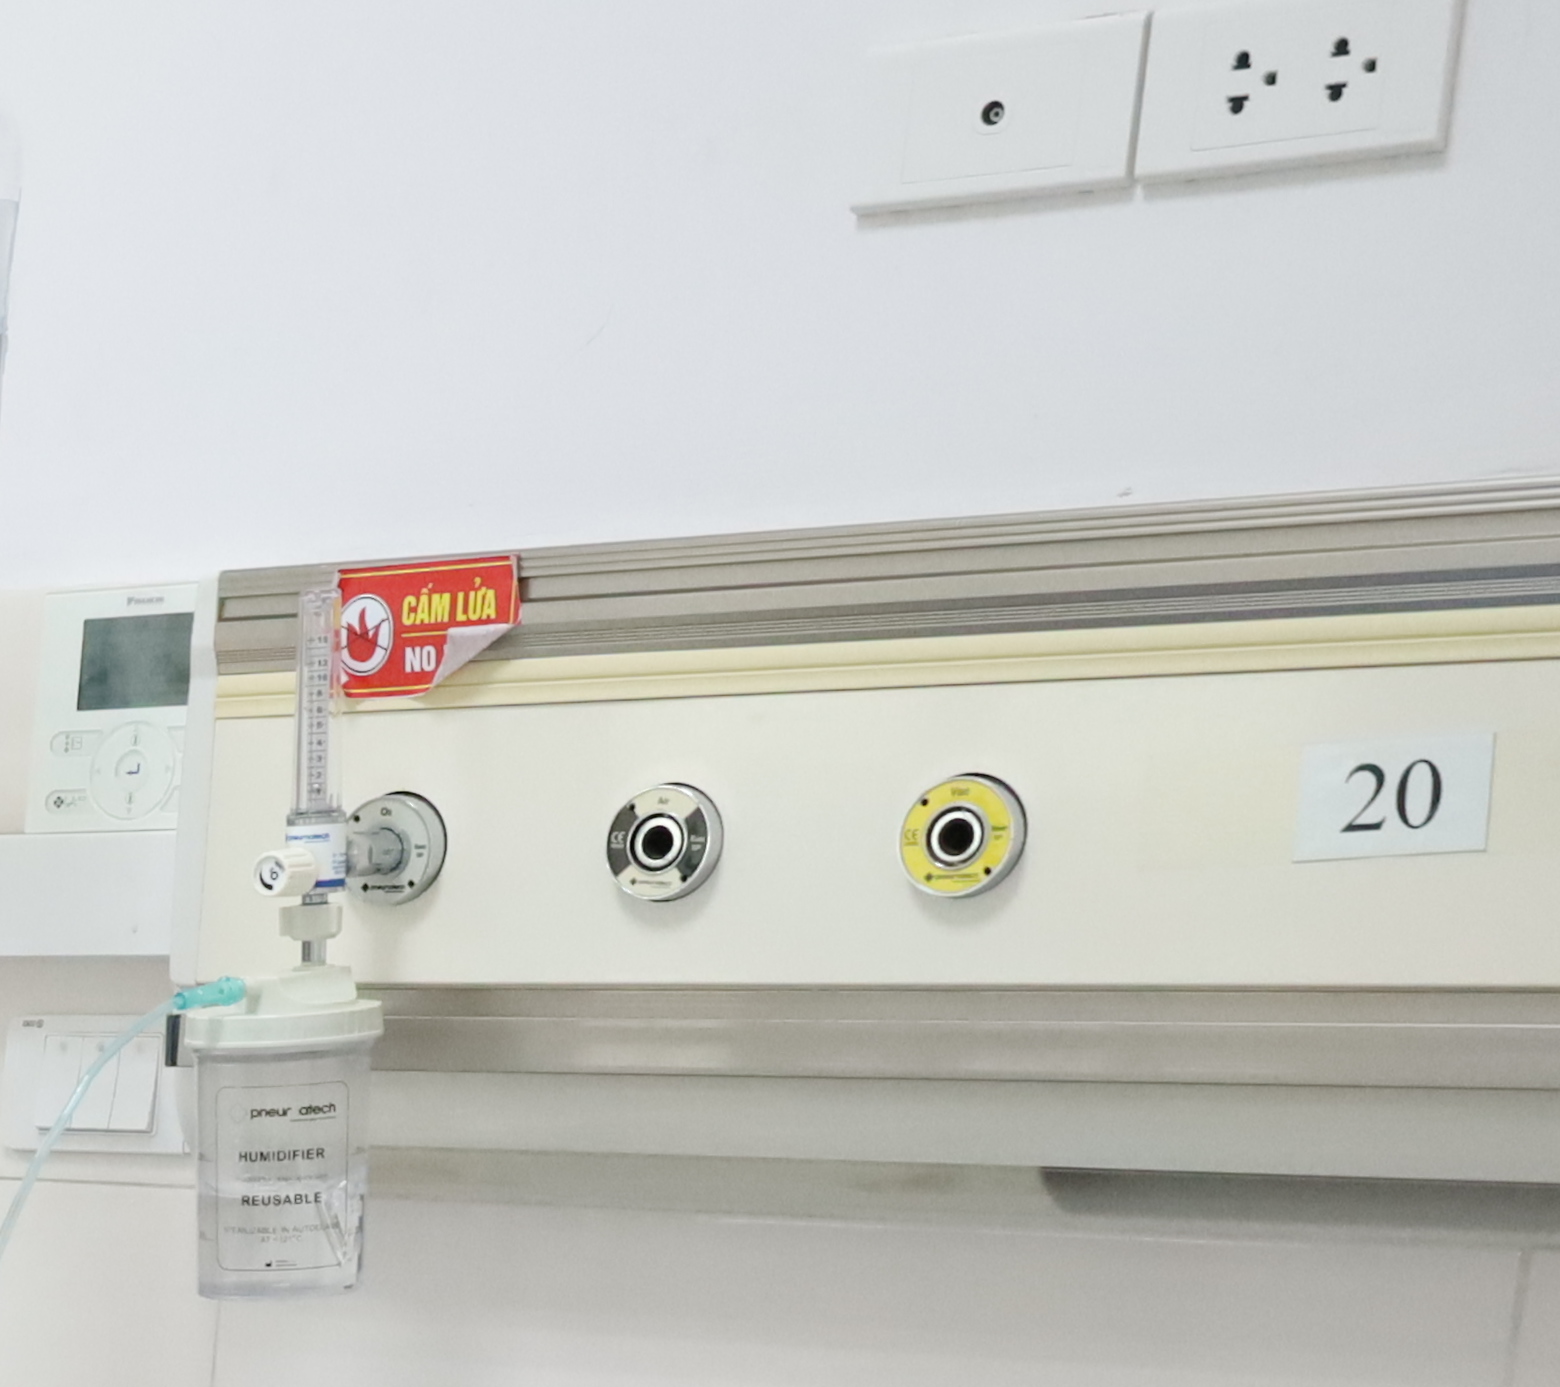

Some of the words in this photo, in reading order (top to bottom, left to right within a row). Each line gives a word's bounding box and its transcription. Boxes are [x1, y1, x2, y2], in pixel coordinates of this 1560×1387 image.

[402, 582, 452, 626] CẤM
[456, 576, 497, 621] LỬA
[405, 645, 437, 673] NO
[1340, 759, 1442, 834] 20
[238, 1147, 326, 1164] HUMIDIFIER
[241, 1191, 323, 1207] REUSABLE
